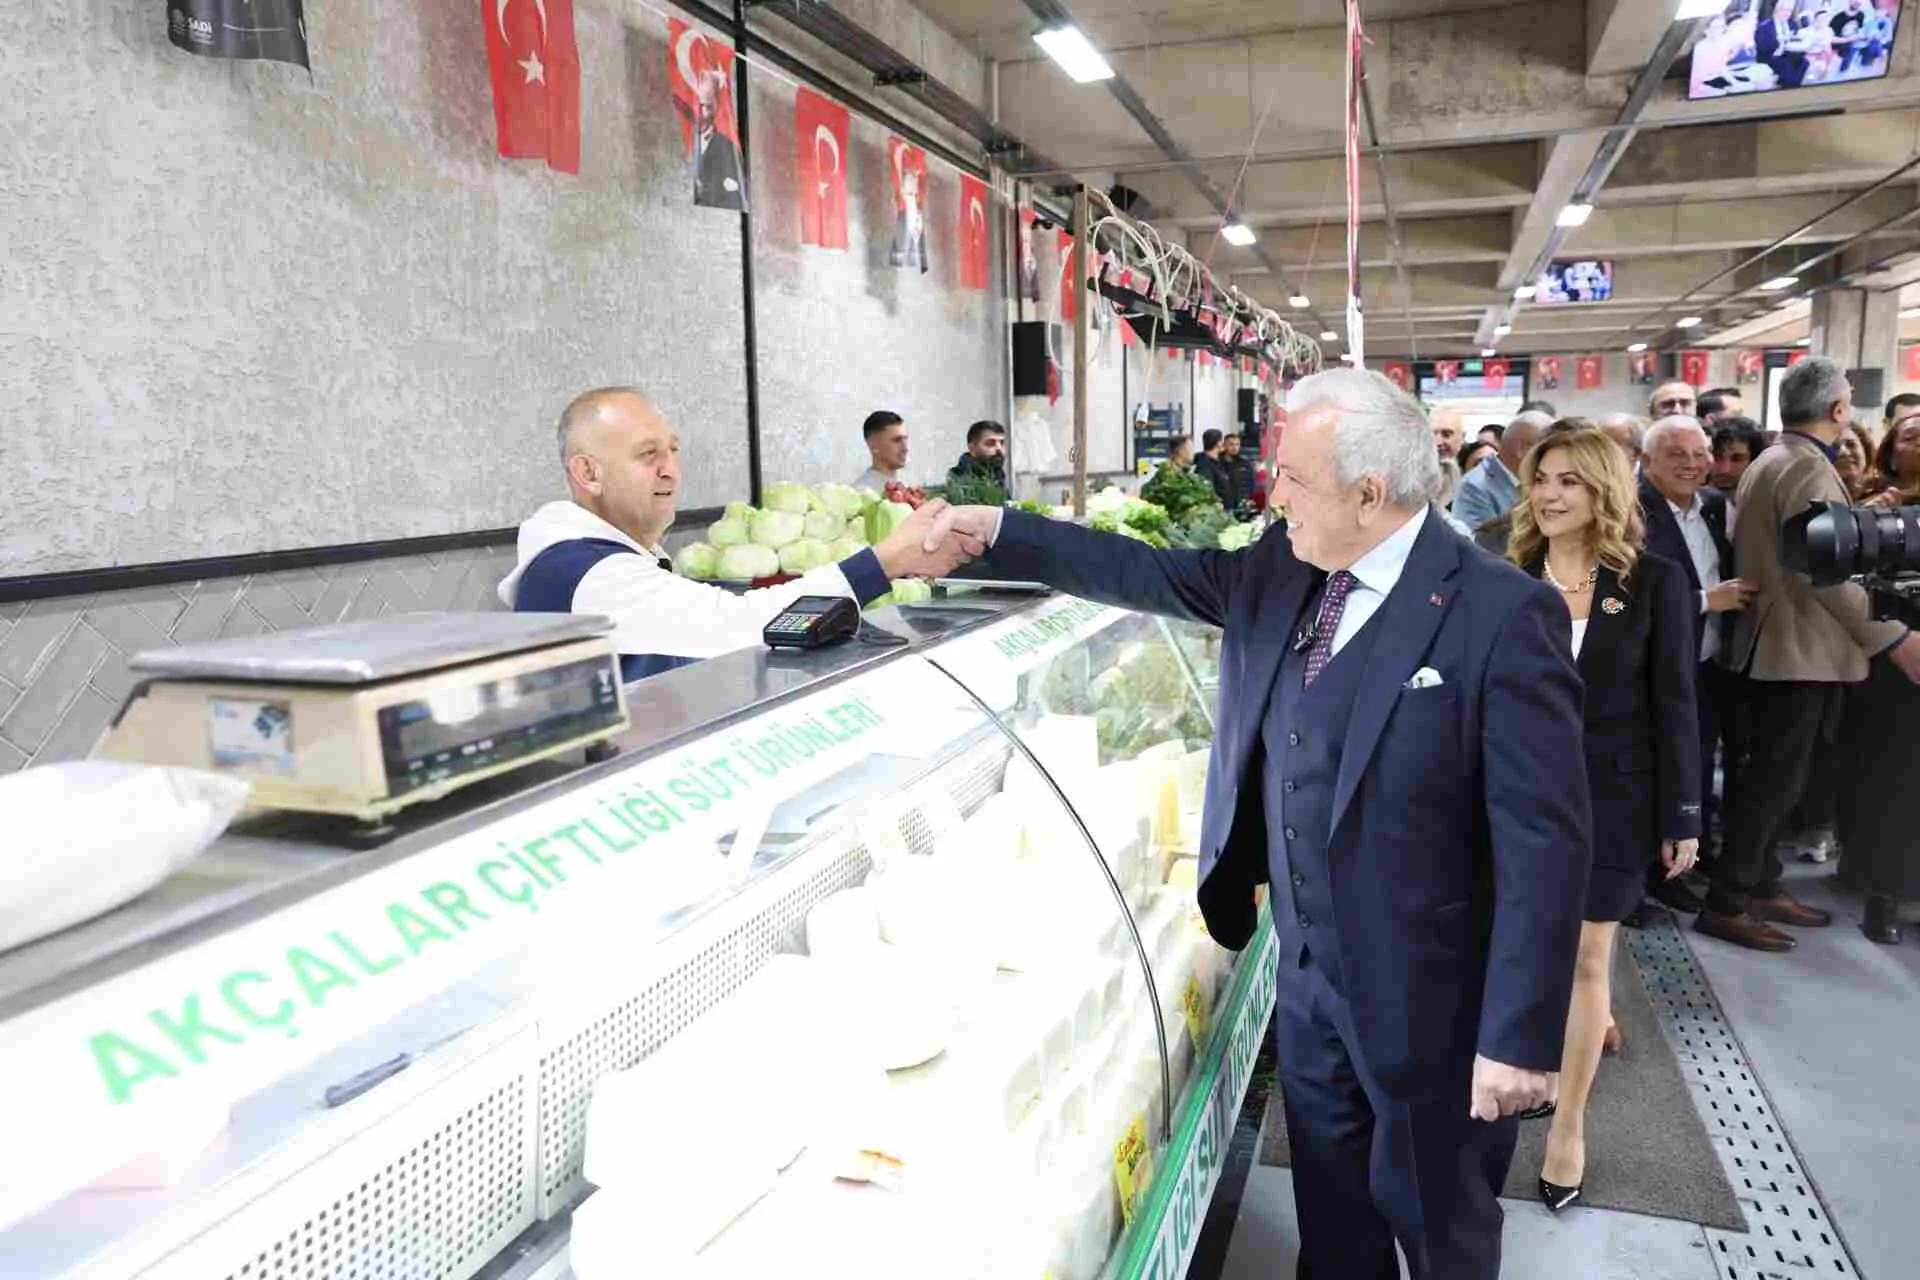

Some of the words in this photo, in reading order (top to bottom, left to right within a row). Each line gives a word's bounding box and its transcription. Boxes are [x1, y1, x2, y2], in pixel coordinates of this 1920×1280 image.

[87, 881, 492, 1104] AKÇALAR
[476, 782, 686, 912] ÇİFTLİĞİ
[666, 758, 752, 811] SÜT
[730, 688, 885, 777] ÜRÜNLERİ
